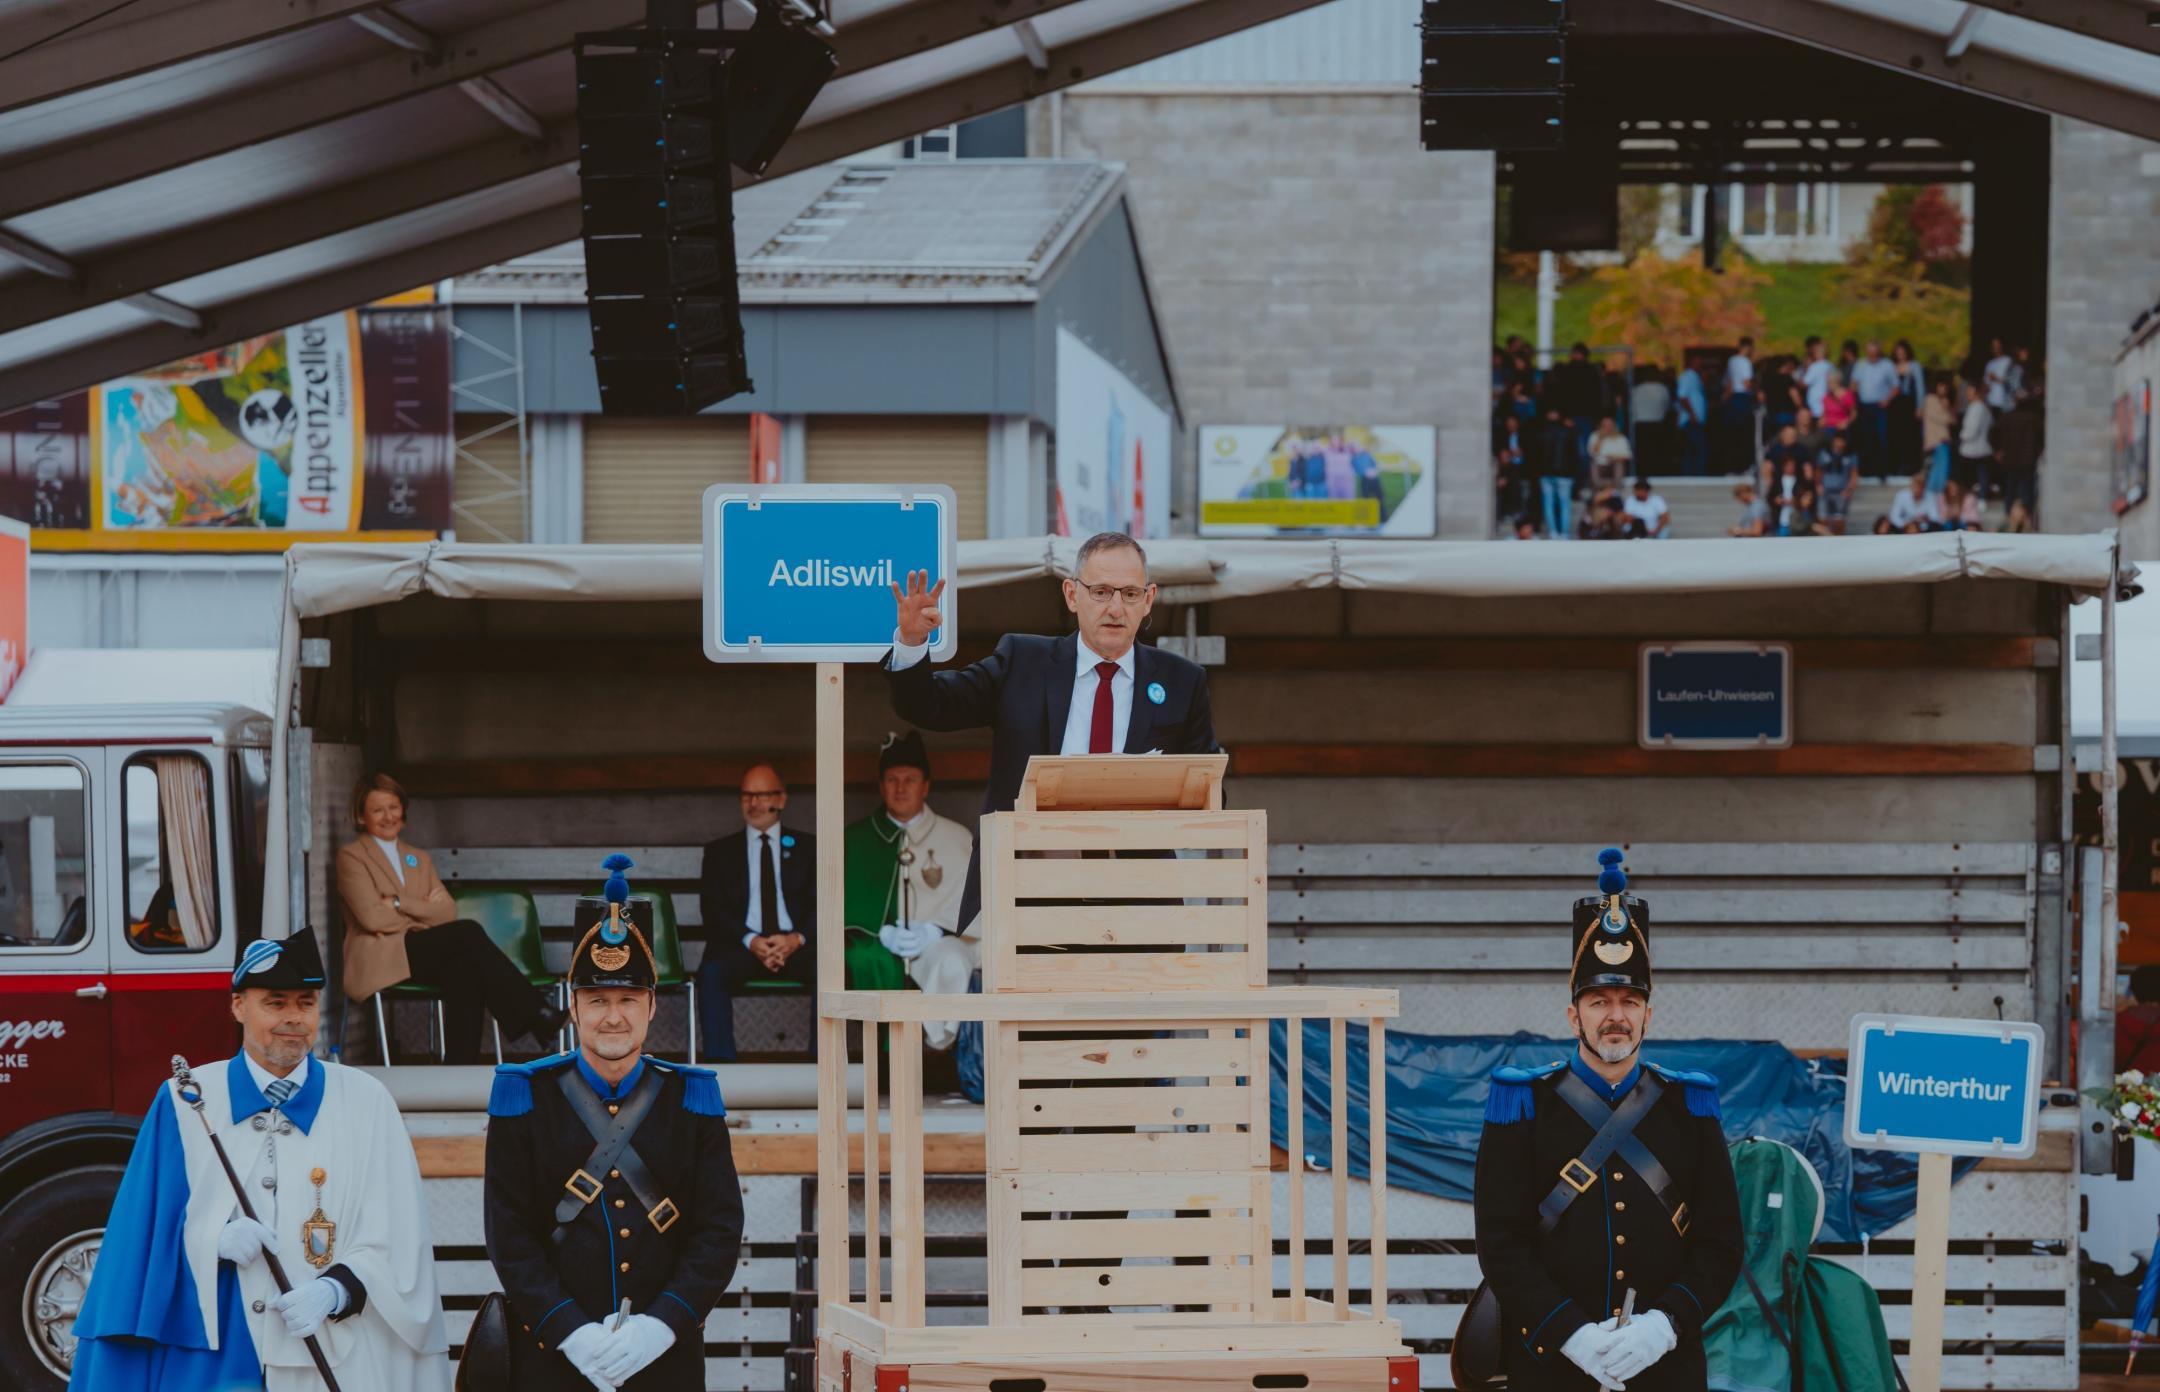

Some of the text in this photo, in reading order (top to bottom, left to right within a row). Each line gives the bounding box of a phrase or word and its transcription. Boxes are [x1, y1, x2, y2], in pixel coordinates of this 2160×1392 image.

[299, 322, 336, 516] Appenzeller
[768, 559, 893, 587] Adliswil
[1656, 689, 1775, 702] Laufen-Uhwiesen
[1878, 1071, 2012, 1102] Winterthur
